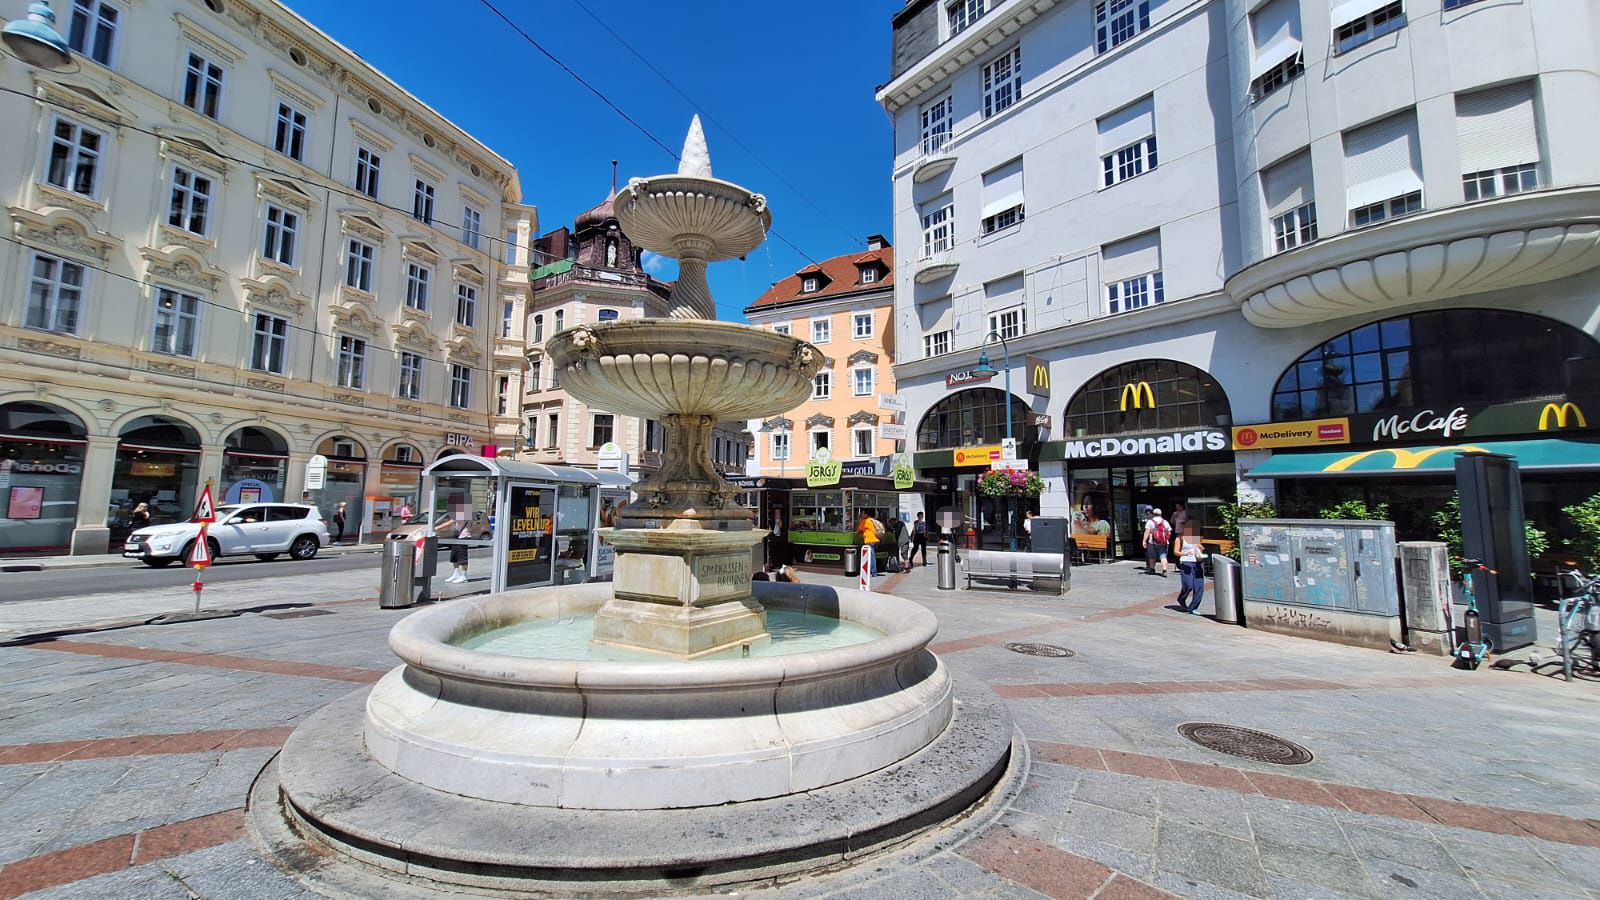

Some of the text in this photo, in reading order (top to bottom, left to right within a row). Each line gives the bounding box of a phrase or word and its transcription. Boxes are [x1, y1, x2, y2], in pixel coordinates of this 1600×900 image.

[1260, 429, 1312, 440] McDelivery
[1373, 407, 1468, 441] McCafé
[447, 432, 474, 447] BIPA
[1064, 431, 1226, 458] McDonald's
